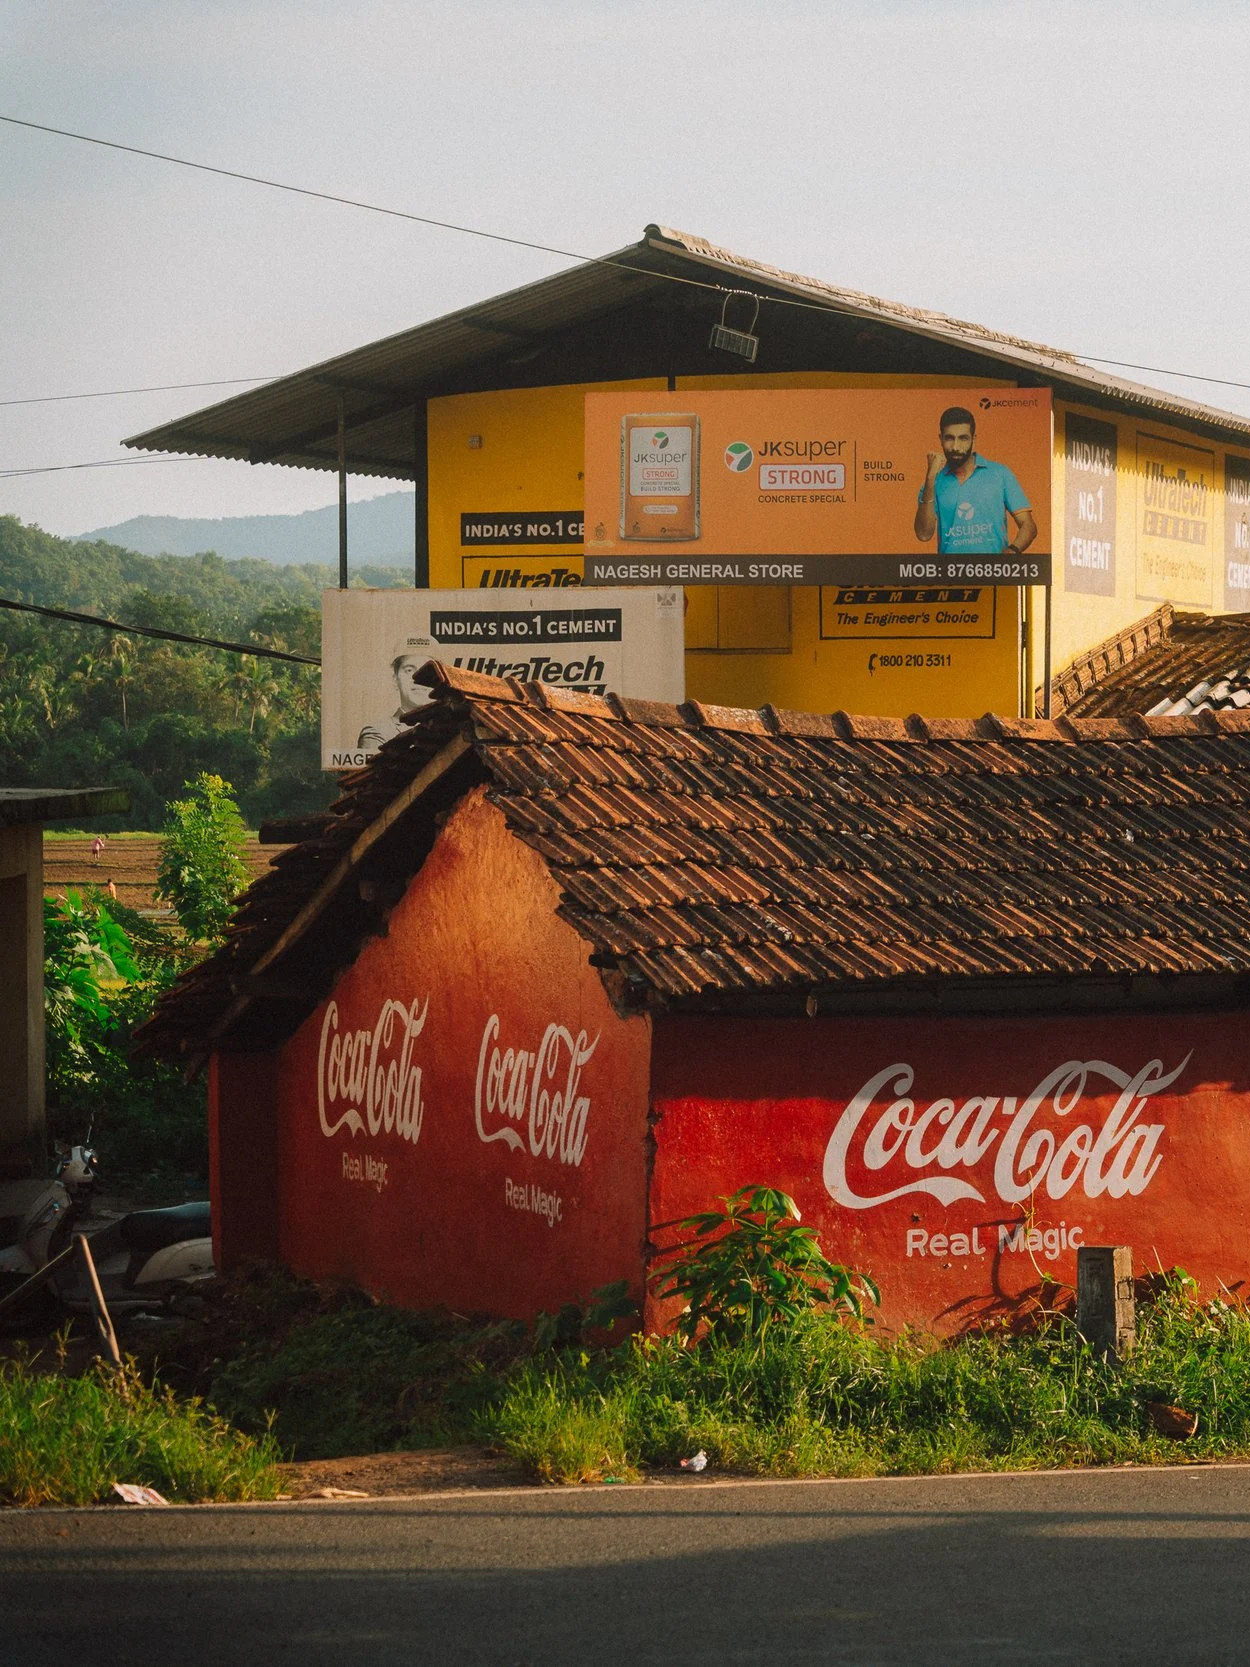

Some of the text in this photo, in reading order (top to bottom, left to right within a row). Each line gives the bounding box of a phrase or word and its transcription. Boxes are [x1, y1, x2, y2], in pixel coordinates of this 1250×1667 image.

[633, 451, 688, 465] JKsuper
[758, 440, 847, 461] JKsuper
[1071, 440, 1111, 478] INDIA'S
[646, 470, 675, 478] STRONG
[863, 461, 893, 470] BUILD
[767, 470, 837, 485] STRONG
[863, 473, 905, 482] STRONG
[1143, 461, 1207, 518] UltraTech
[758, 495, 846, 503] CONCRETE SPECIAL
[1078, 485, 1104, 524] NO.1
[465, 524, 522, 537] INDIA'S
[526, 519, 563, 537] NO.1
[1069, 536, 1111, 571] CEMENT
[480, 568, 584, 588] UltraTe
[593, 564, 804, 579] NAGESH GENERAL STORE
[898, 563, 1040, 578] MOB: 8766850213
[842, 590, 974, 603] CEMENT
[435, 615, 617, 636] INDIA'S NO.1 CEMENT
[836, 609, 979, 627] The Engineer's Choice
[879, 653, 951, 667] 1800 210 3311
[822, 1047, 1195, 1210] Coca-Cola
[342, 1151, 389, 1193] Real Magic
[505, 1177, 563, 1228] Real Magic
[905, 1220, 1086, 1261] Real Magic
